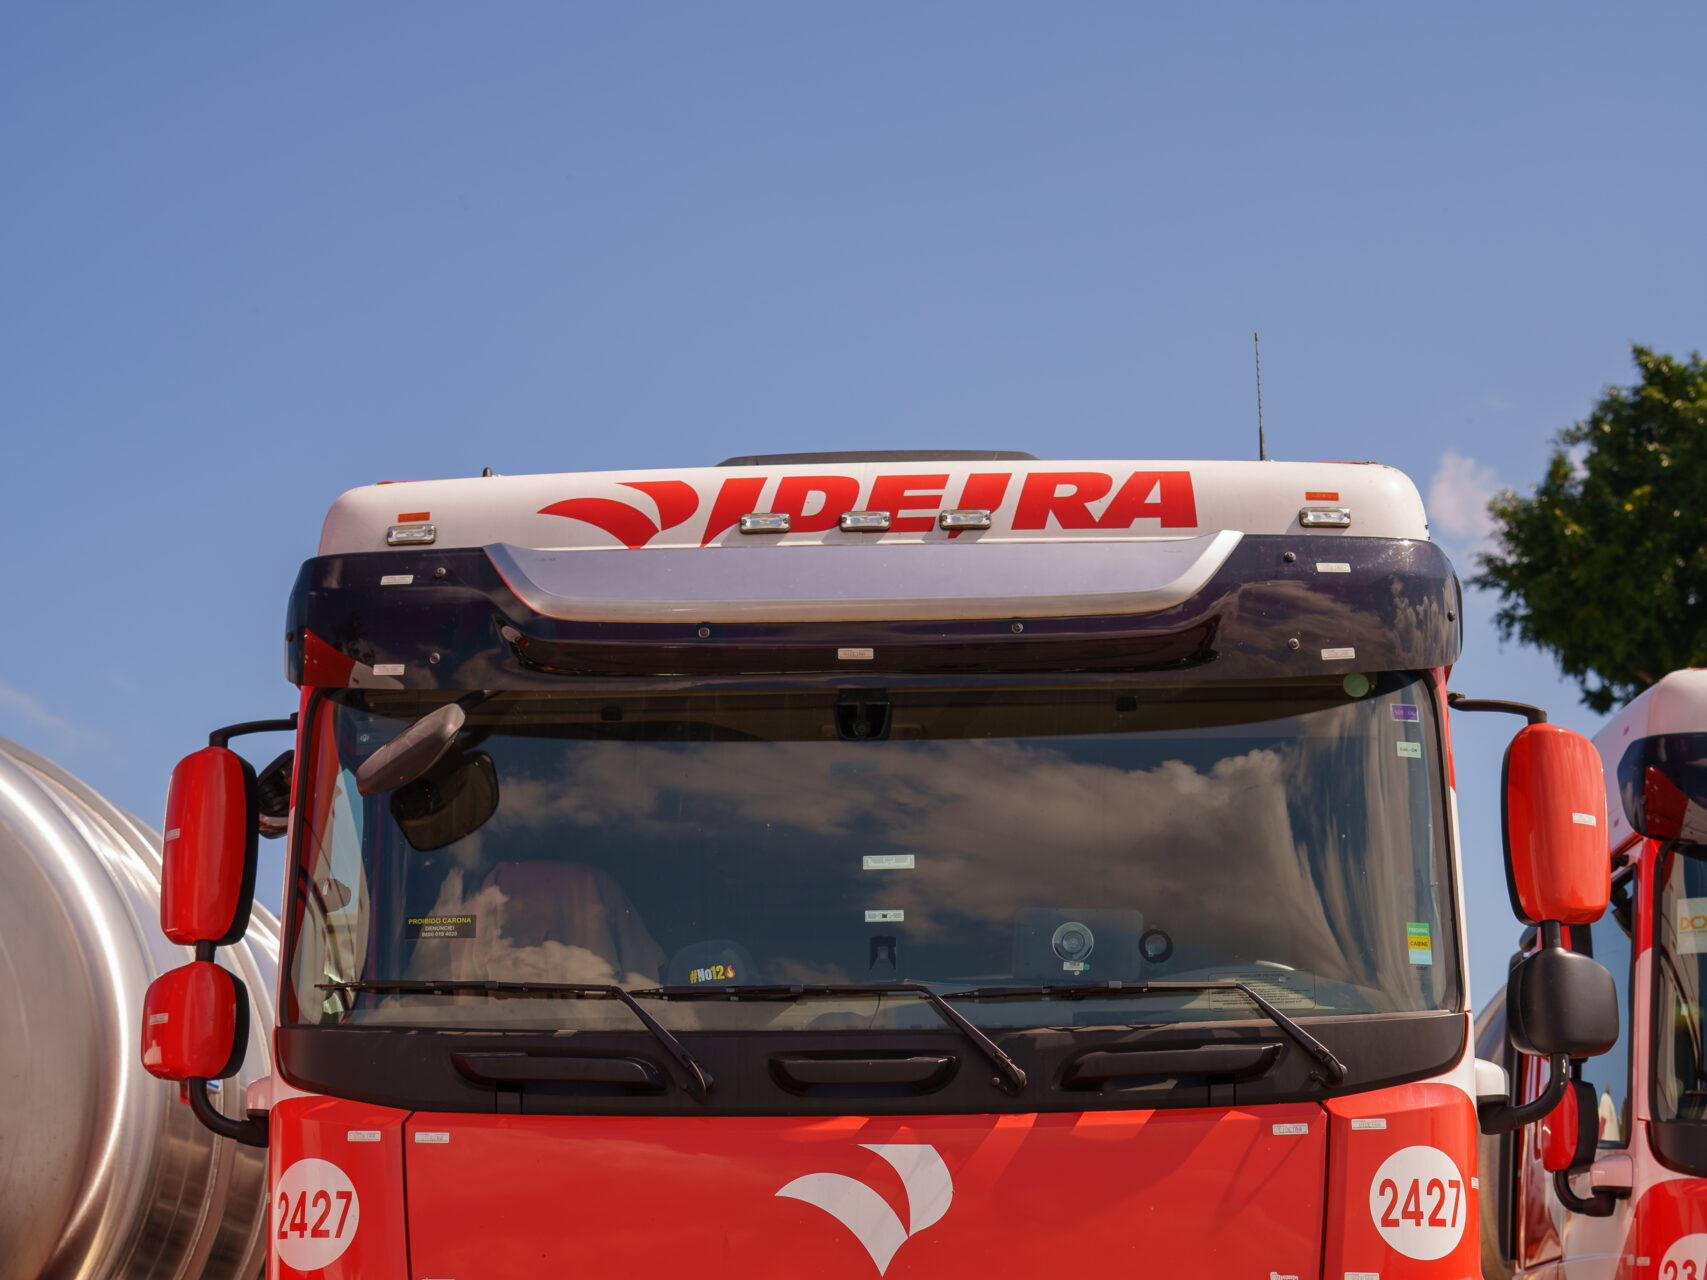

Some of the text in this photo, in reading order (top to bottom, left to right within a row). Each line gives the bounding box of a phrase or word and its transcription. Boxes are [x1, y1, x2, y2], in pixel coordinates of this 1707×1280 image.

[442, 916, 471, 924] CARONA
[277, 1189, 353, 1240] 2427
[1378, 1177, 1461, 1228] 2427
